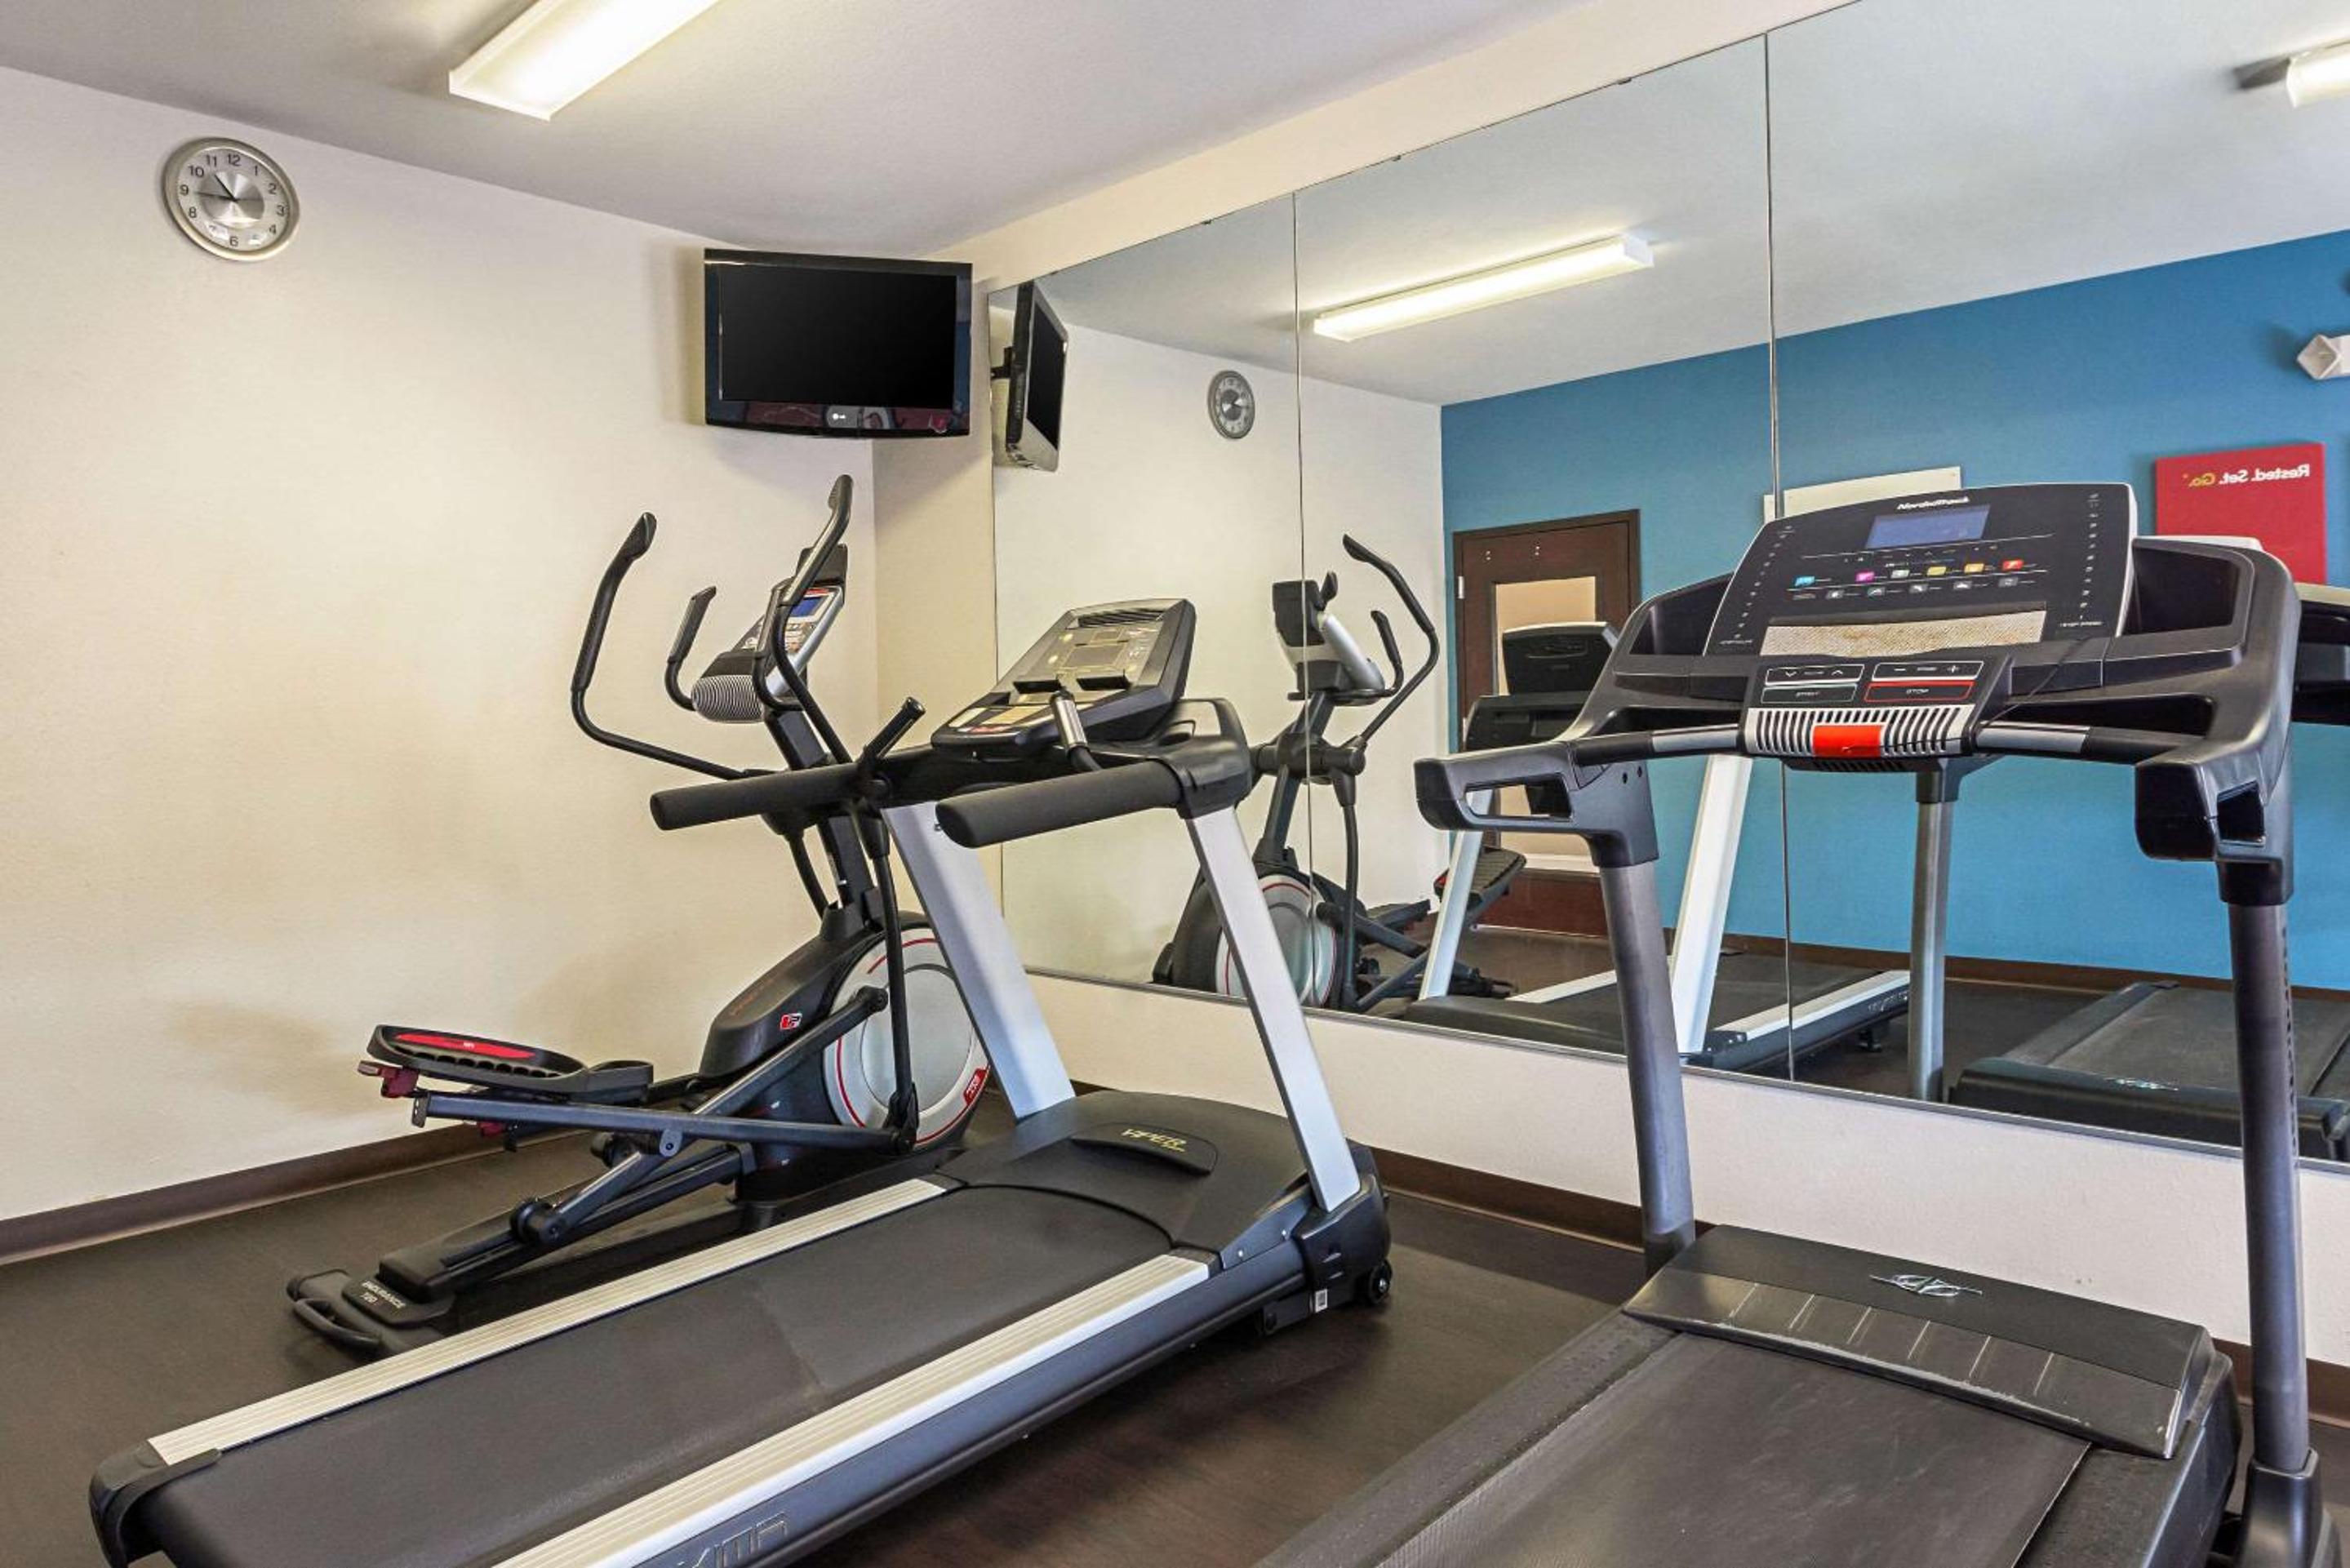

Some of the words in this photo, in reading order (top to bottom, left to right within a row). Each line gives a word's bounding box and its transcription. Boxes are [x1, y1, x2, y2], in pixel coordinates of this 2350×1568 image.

[207, 154, 217, 167] 11
[227, 153, 241, 167] 12
[188, 165, 205, 178] 10
[179, 184, 189, 196] 9
[268, 182, 278, 195] 2
[188, 206, 198, 219] 8
[276, 204, 285, 217] 3
[269, 224, 278, 235] 4
[229, 235, 239, 247] 6
